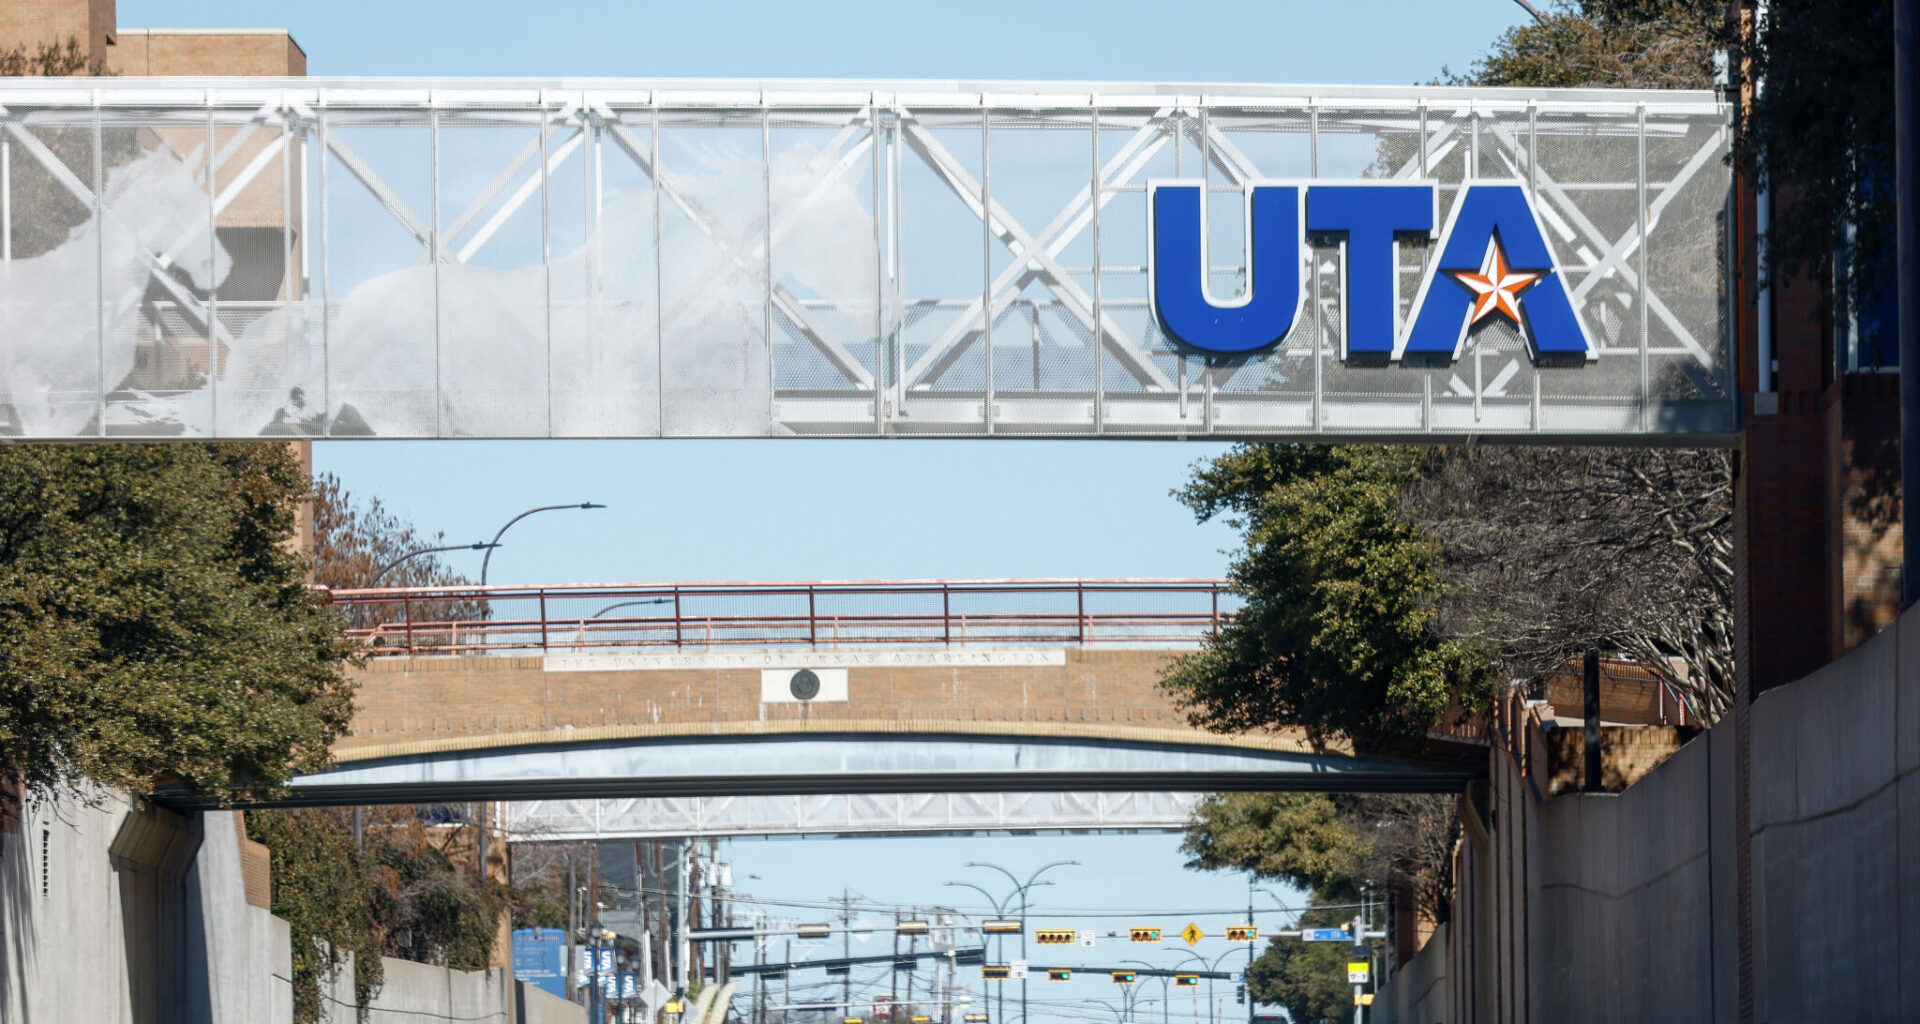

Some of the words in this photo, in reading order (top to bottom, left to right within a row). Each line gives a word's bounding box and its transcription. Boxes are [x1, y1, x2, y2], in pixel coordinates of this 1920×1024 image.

[1148, 179, 1598, 361] UTA
[560, 658, 598, 668] THE
[613, 655, 748, 668] UNIVERSITY
[763, 654, 787, 665] OF
[803, 653, 875, 665] TEXAS
[928, 652, 1050, 664] ARLINGTON
